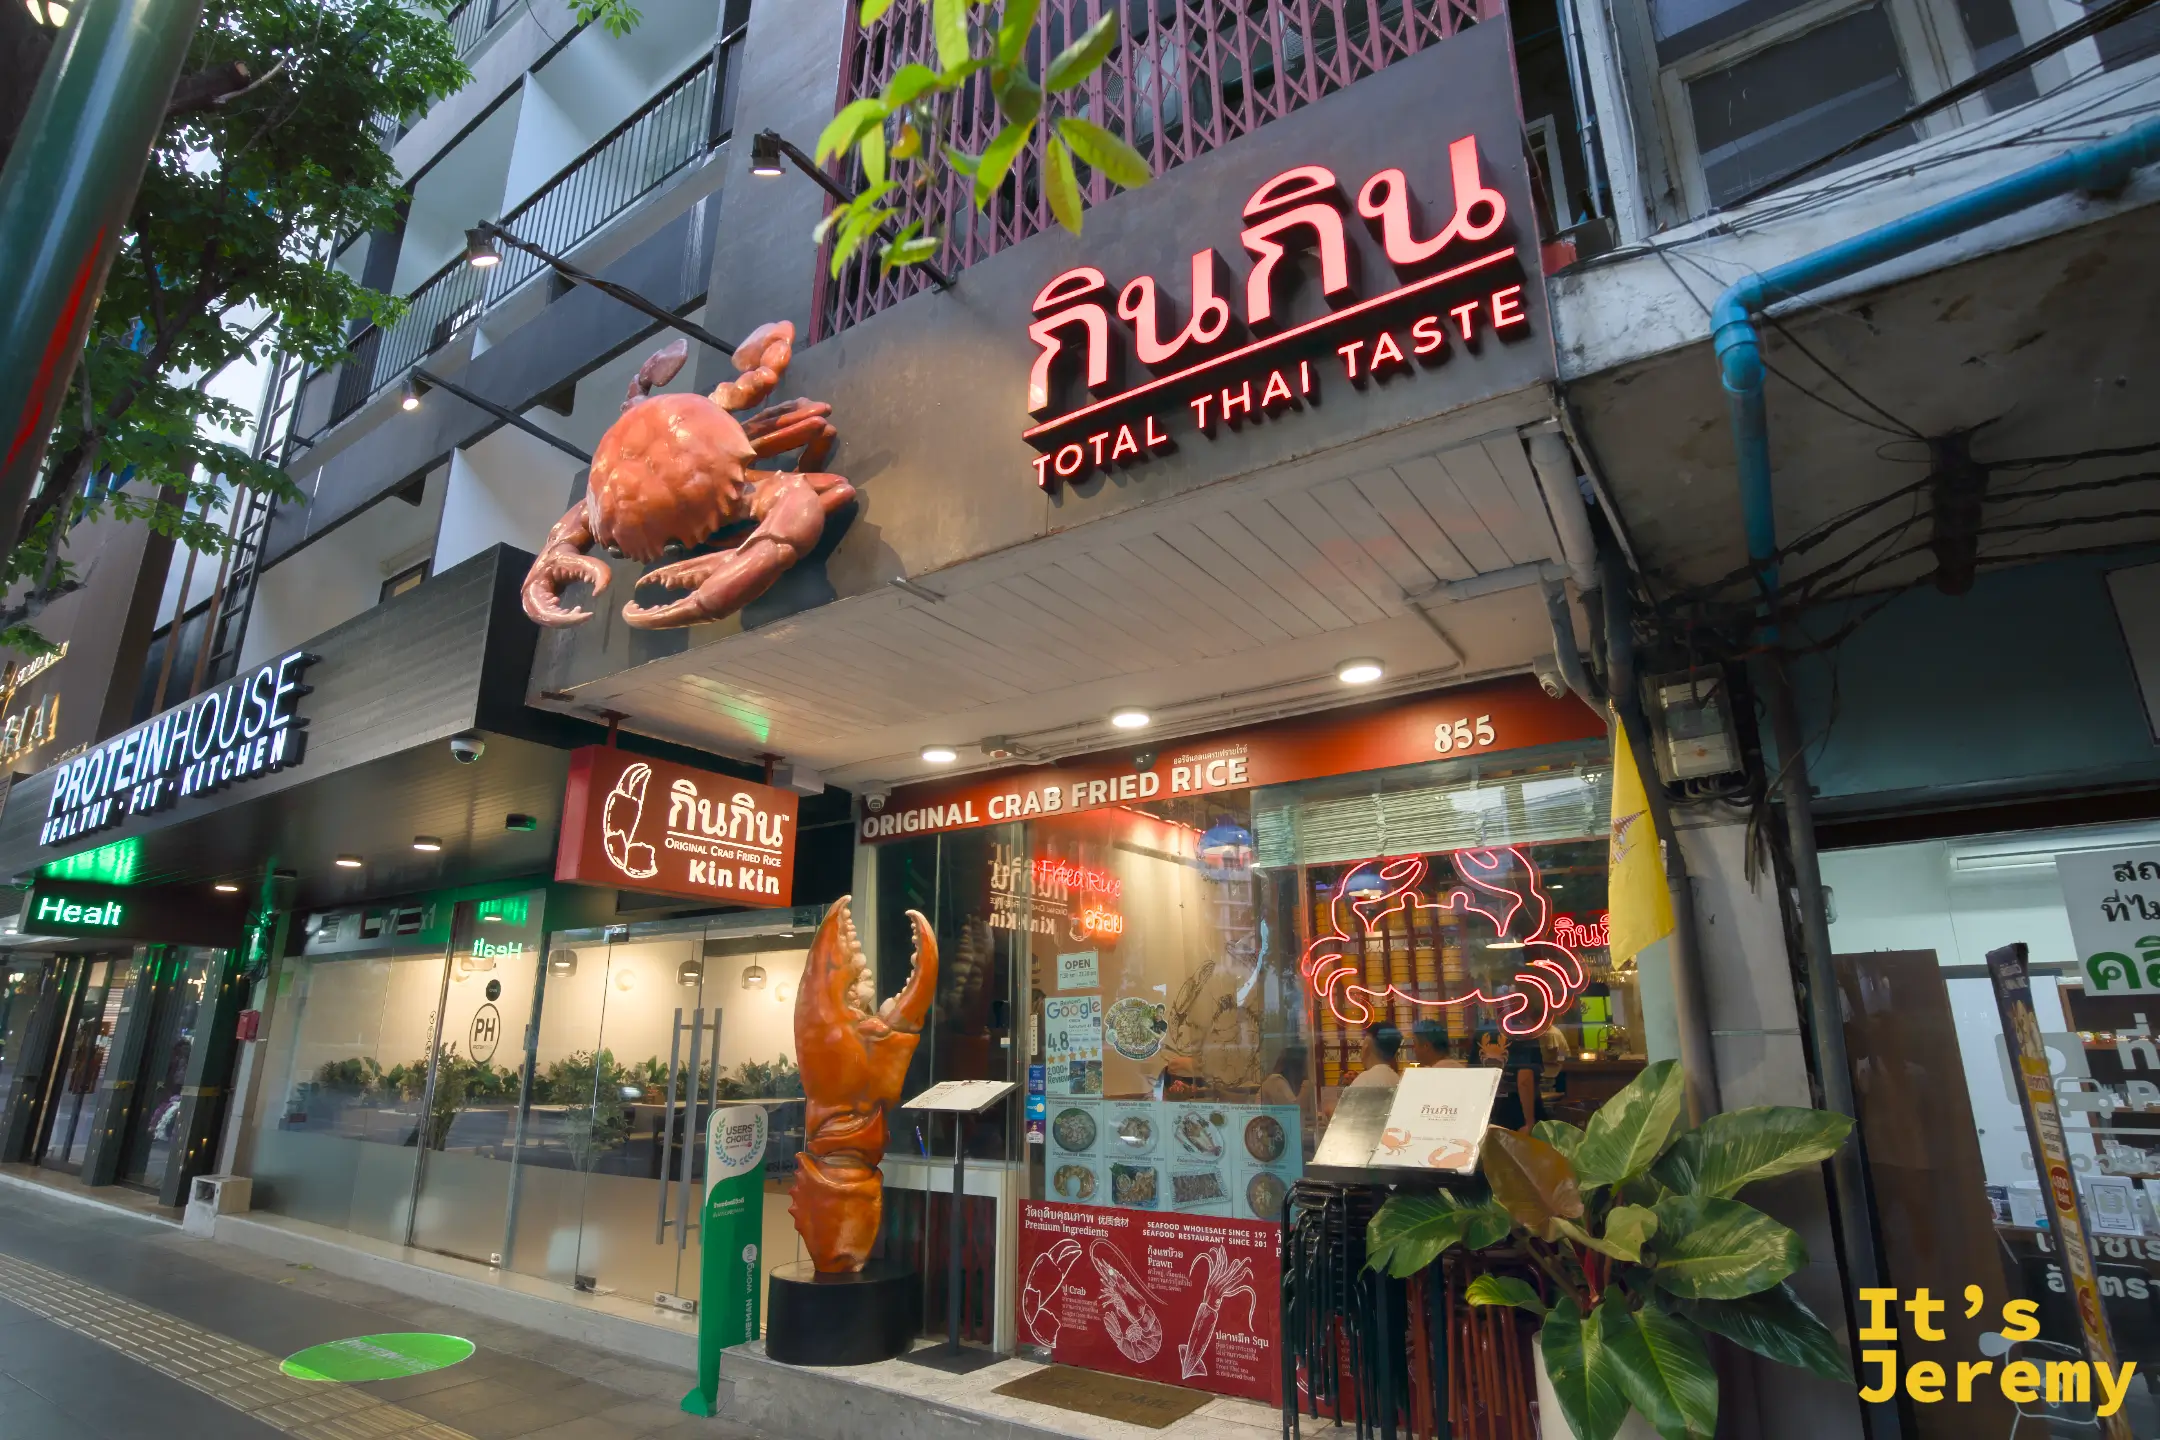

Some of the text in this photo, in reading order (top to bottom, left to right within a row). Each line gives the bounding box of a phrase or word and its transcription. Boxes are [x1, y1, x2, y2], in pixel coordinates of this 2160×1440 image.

[1027, 134, 1507, 415] กินกิน
[1032, 285, 1525, 487] TOTAL THAI TASTE
[48, 652, 303, 817] PROTEINHOUSE
[1433, 715, 1496, 753] 855
[40, 728, 289, 846] HEALTHY FIT KITCHEN
[863, 757, 1249, 838] ORIGINAL CRAB FRIED RICE
[669, 779, 783, 847] กินกิน
[665, 838, 781, 867] ORIGINAL CRAB FRIED RICE
[689, 859, 780, 894] Kin Kin
[1088, 871, 1121, 897] Rice
[38, 897, 122, 927] Healt
[1085, 904, 1123, 934] อร่อย
[1065, 959, 1091, 970] OPEN
[1046, 997, 1100, 1020] Google
[474, 1018, 496, 1041] PH
[1048, 1031, 1070, 1052] 4.8
[726, 1134, 753, 1145] CHOICE
[1025, 1220, 1109, 1238] Premium Ingredients
[1142, 1229, 1175, 1239] SEAFOOD
[1178, 1232, 1225, 1244] RESTAURANT
[1228, 1238, 1250, 1247] SINCE
[1147, 1221, 1180, 1231] SEAFOOD
[1183, 1225, 1227, 1235] WHOLESALE
[1228, 1229, 1250, 1238] SINCE
[1148, 1257, 1173, 1269] Prawn
[1070, 1285, 1087, 1296] Crab
